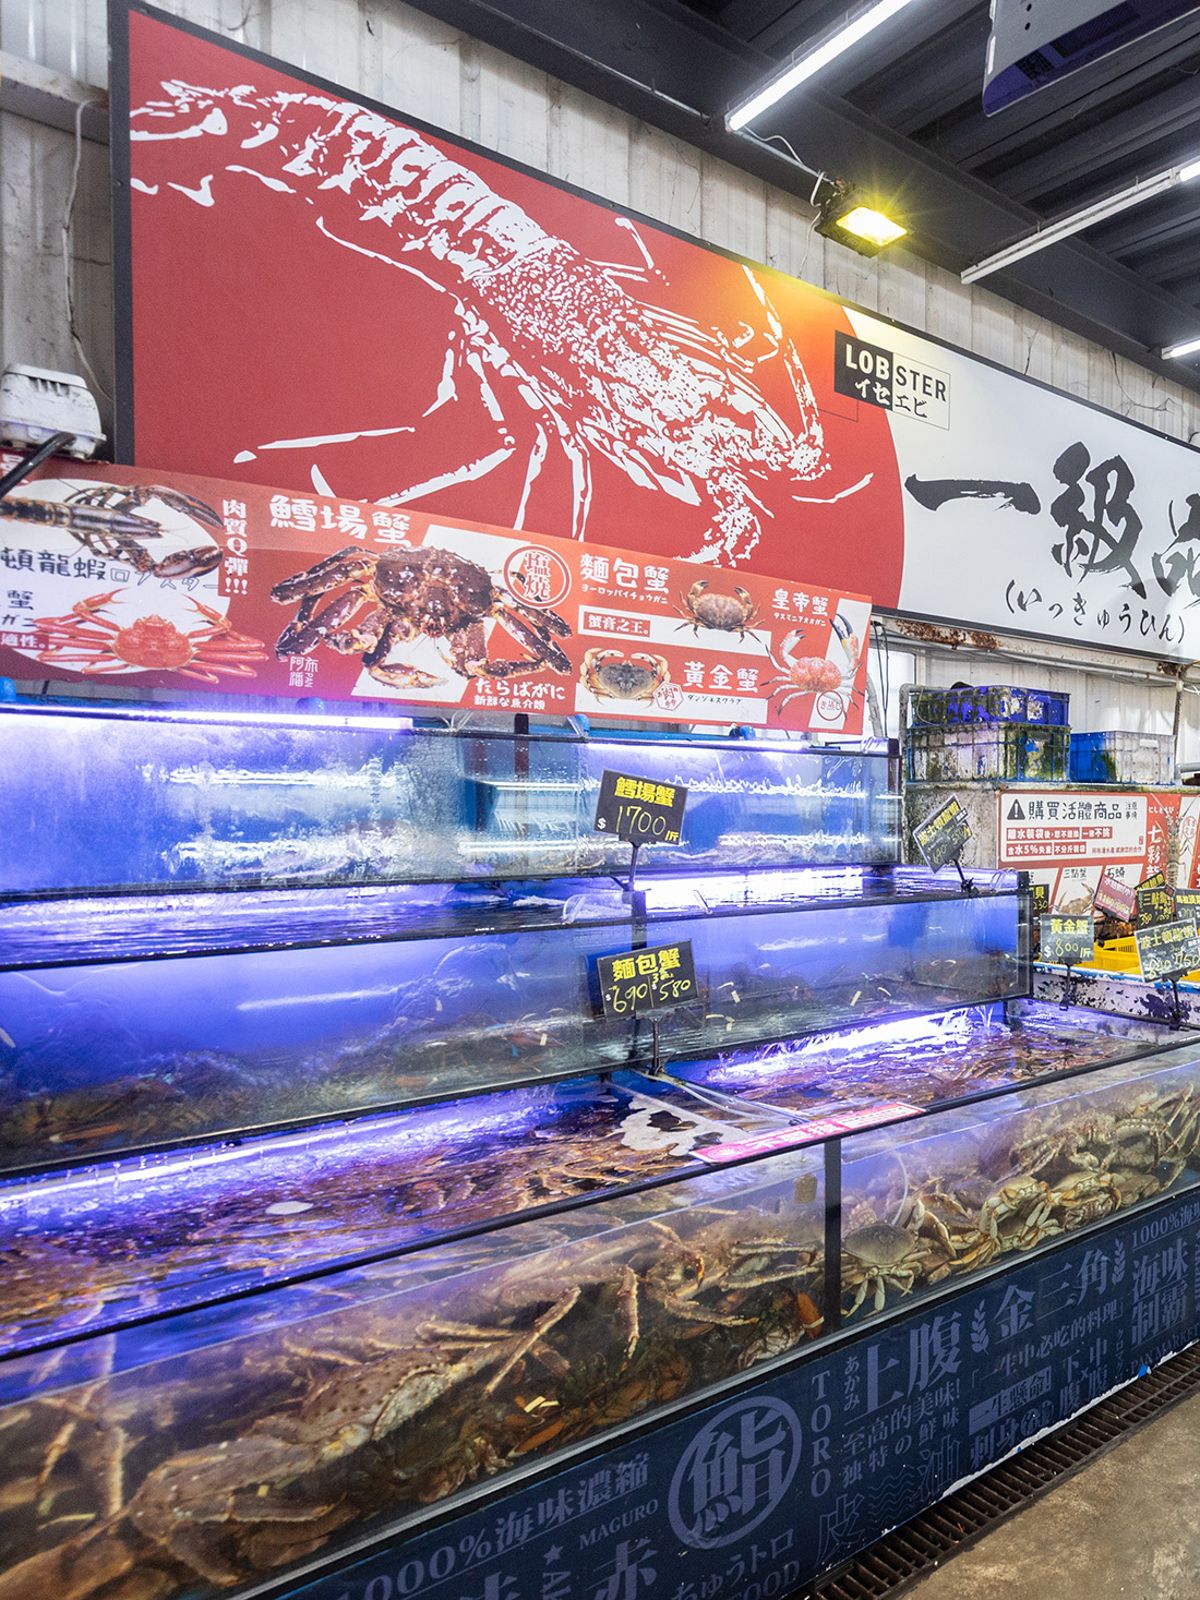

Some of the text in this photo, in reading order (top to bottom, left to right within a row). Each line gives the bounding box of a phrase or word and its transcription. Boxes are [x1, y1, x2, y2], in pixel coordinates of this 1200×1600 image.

[845, 343, 947, 402] LOBSTER
[855, 378, 928, 420] イセエビ
[269, 494, 413, 547] 鱈場蟹
[580, 552, 671, 595] 麵包蟹
[772, 587, 829, 617] 皇帝蟹
[475, 678, 566, 700] たらばがに
[614, 776, 676, 808] 鱈場蟹
[1028, 801, 1122, 820] 購買活體商品
[597, 818, 607, 829] $
[611, 948, 681, 982] 麵包蟹
[1132, 1237, 1189, 1300] 海味
[993, 1249, 1111, 1345] 金三角
[843, 1355, 860, 1412] あかみ
[866, 1311, 963, 1415] 上腹
[811, 1370, 832, 1498] TORO
[578, 1498, 659, 1551] MAGURO
